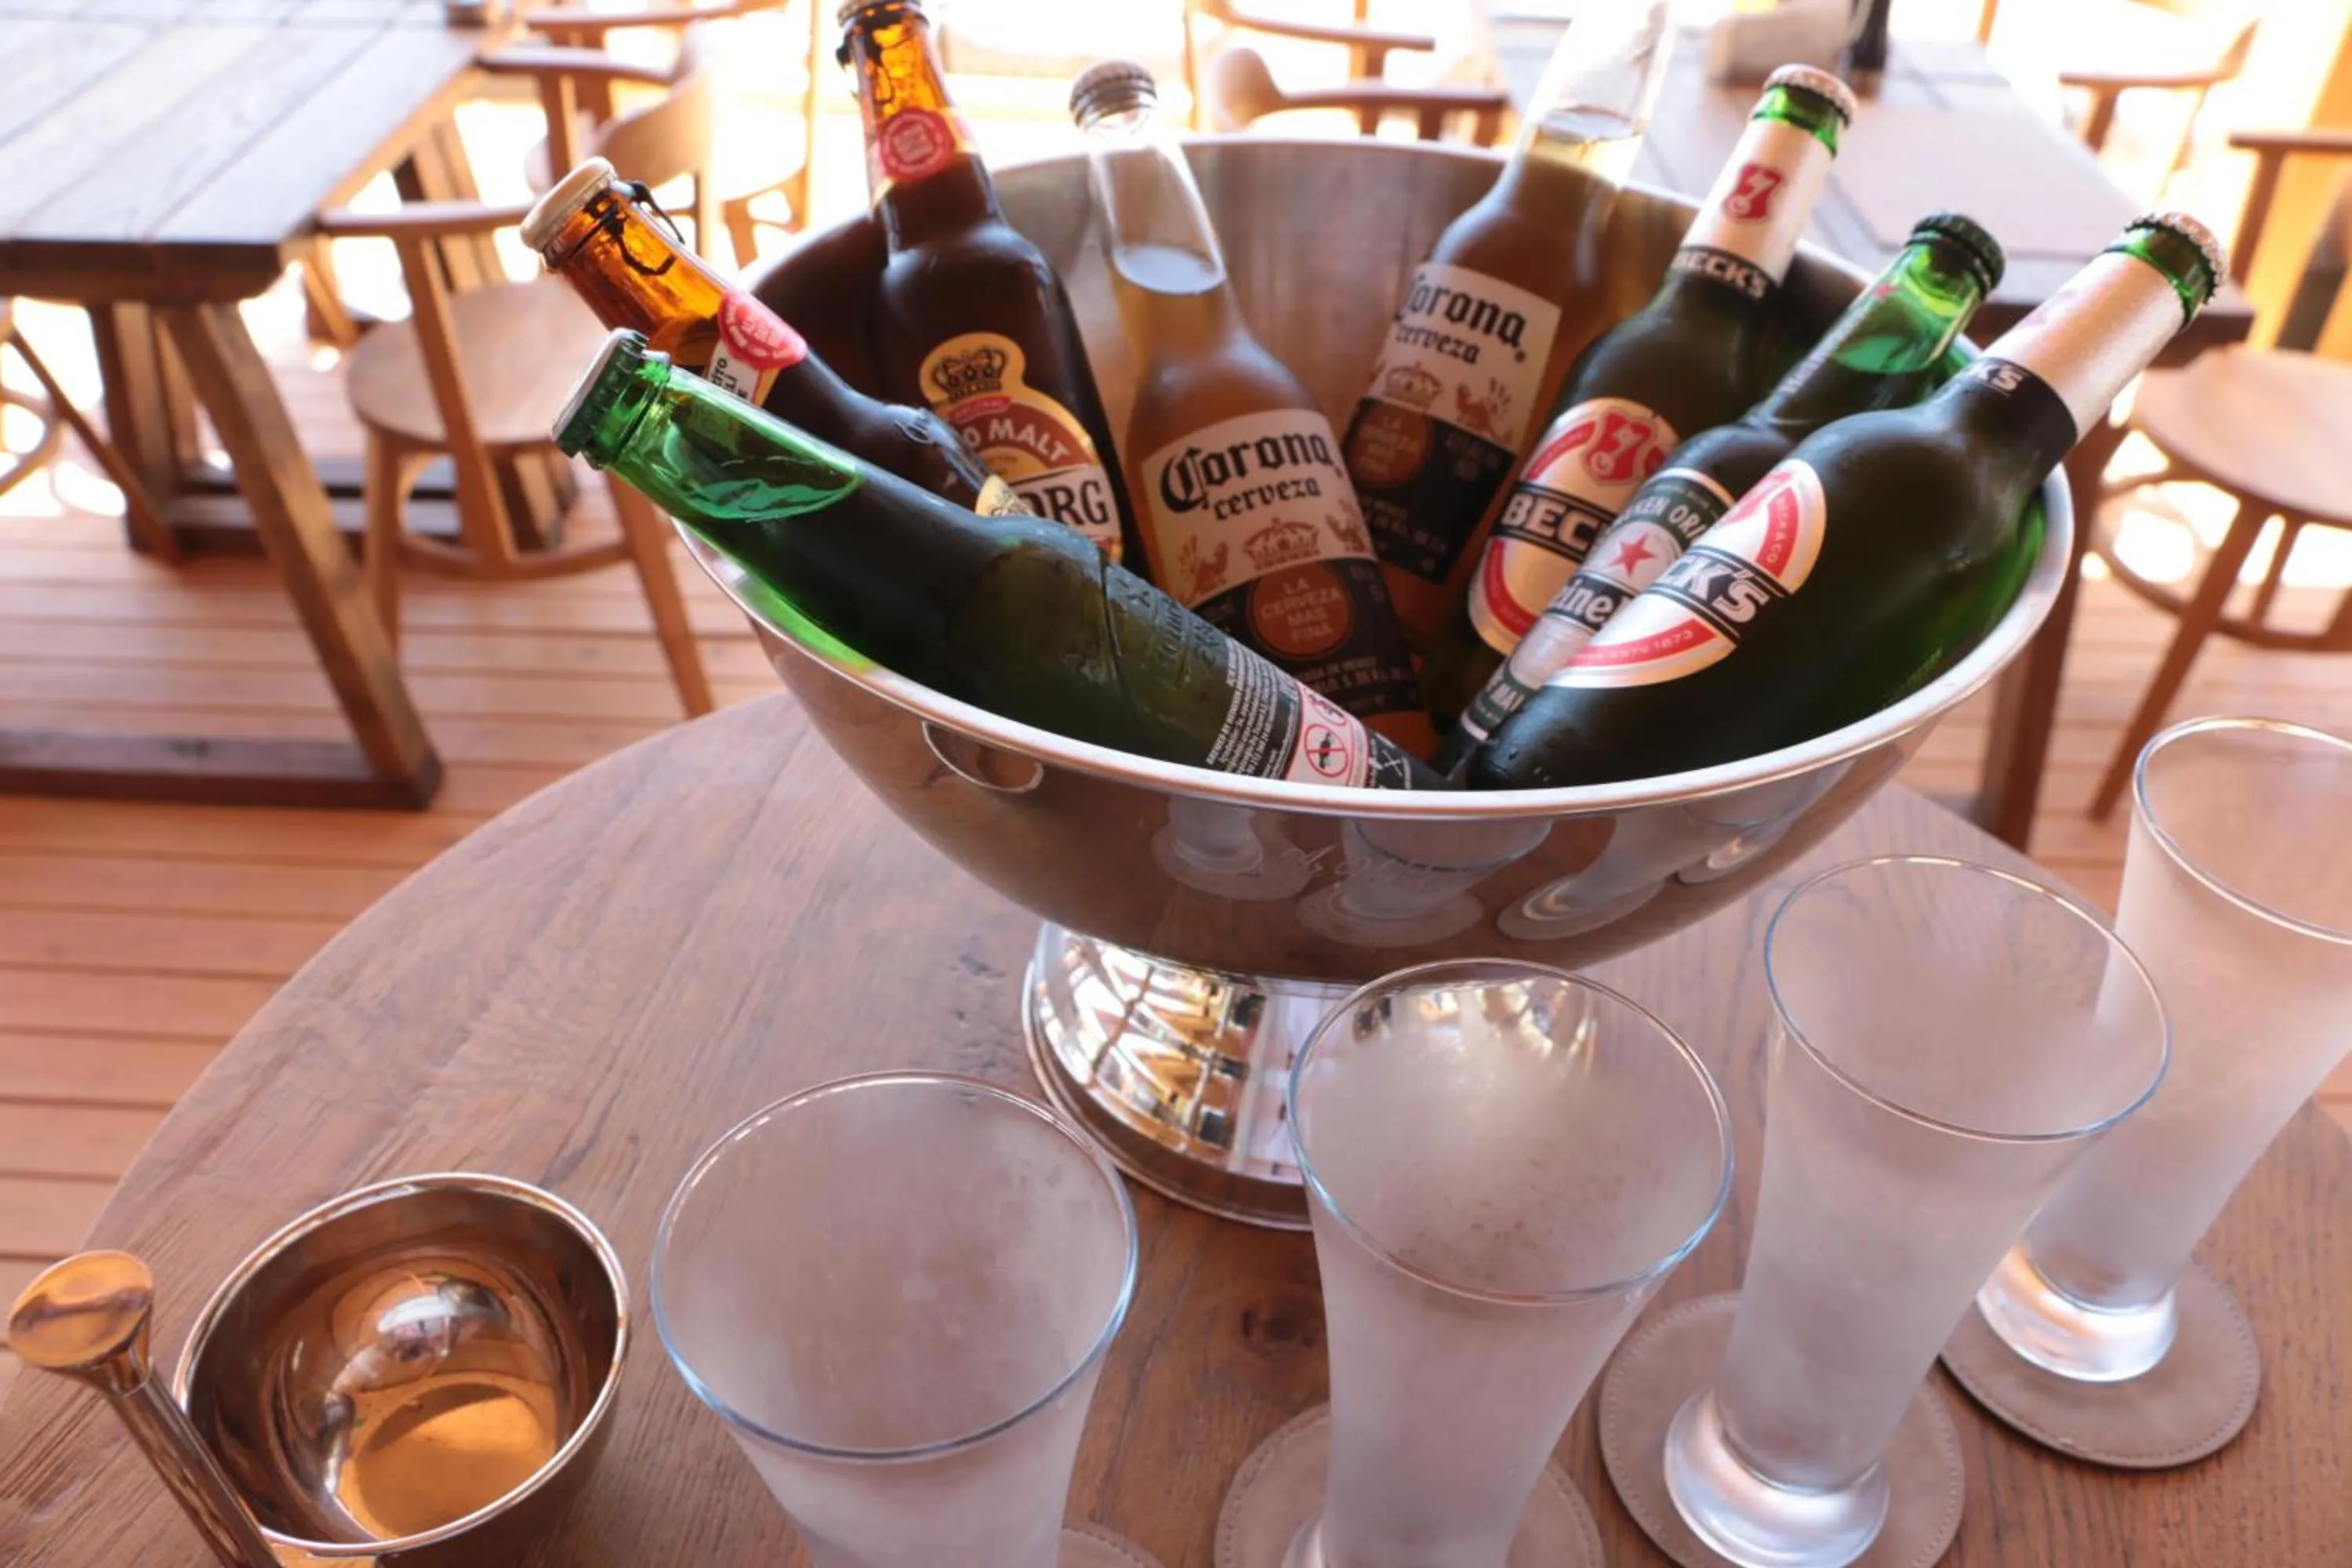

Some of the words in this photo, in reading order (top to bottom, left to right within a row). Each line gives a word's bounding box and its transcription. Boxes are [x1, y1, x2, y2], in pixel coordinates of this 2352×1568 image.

[989, 417, 1071, 462] MALT
[1160, 432, 1334, 514] Corona
[1214, 477, 1322, 521] cerveza
[1501, 493, 1604, 552] BEC
[1261, 586, 1345, 620] CERVEZA
[1283, 576, 1312, 594] LA
[1290, 624, 1333, 644] FINA
